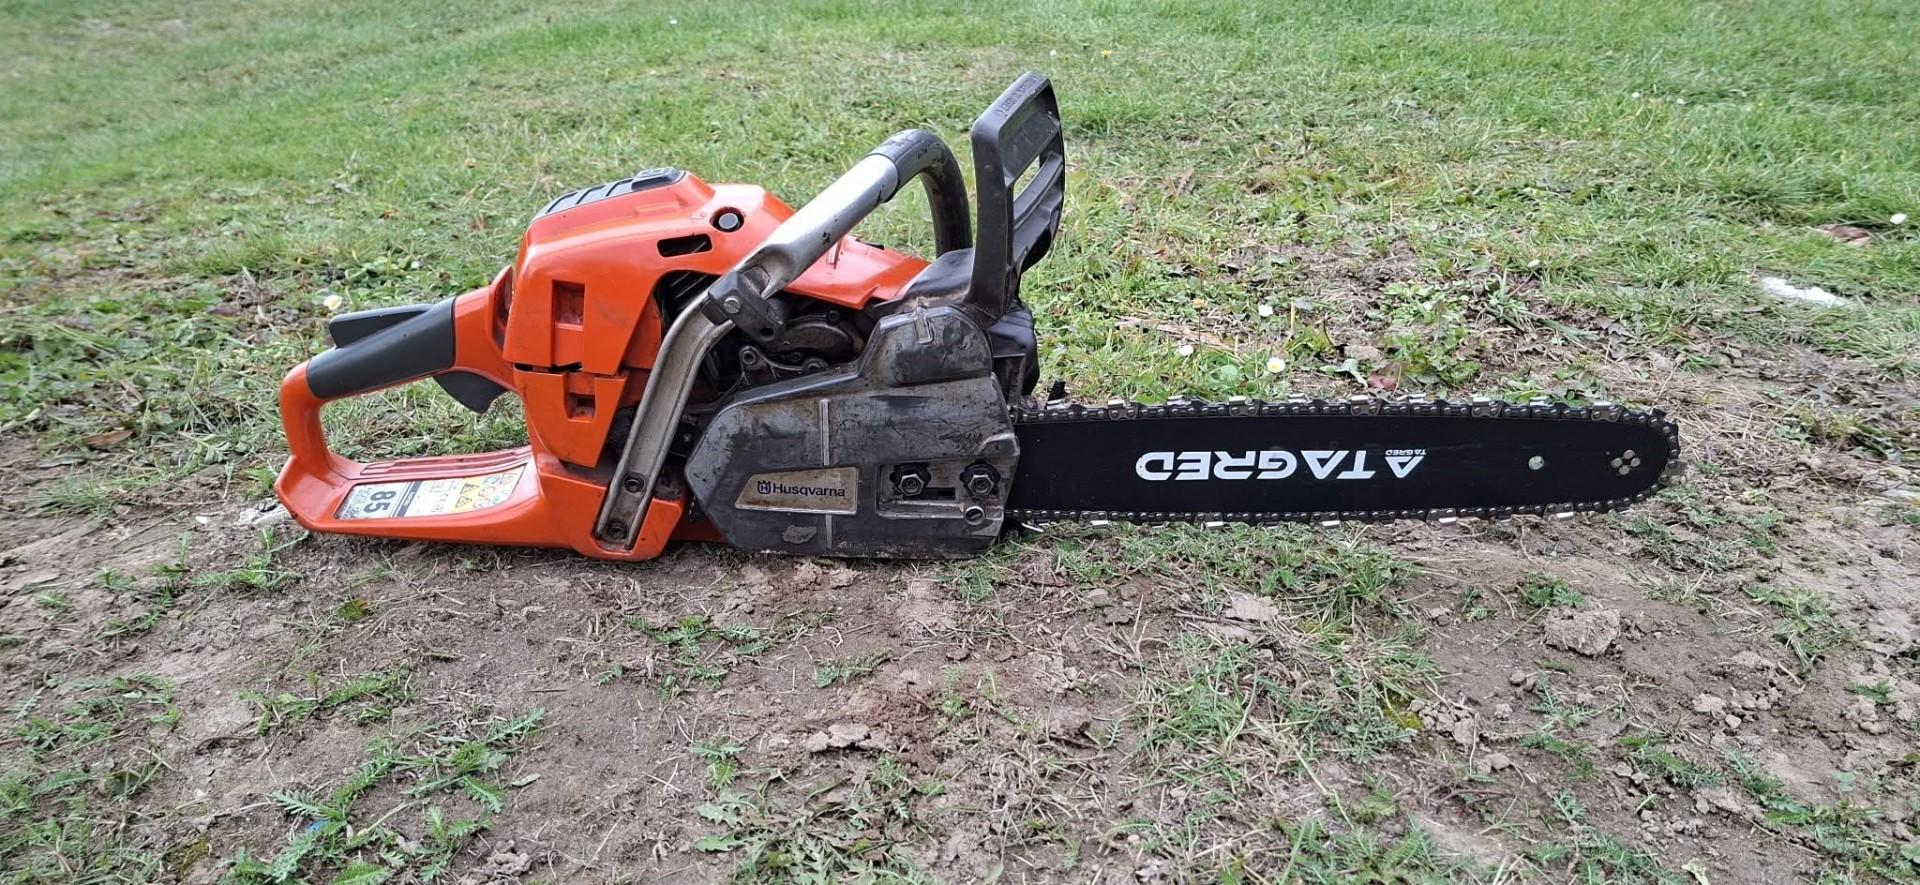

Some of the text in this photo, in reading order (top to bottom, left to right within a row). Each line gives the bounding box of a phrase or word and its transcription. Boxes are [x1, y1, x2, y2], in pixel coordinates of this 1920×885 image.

[1385, 448, 1427, 456] TAGRED
[1135, 450, 1377, 481] TAGRED
[773, 483, 846, 497] Husqvarna
[363, 490, 397, 513] 85
